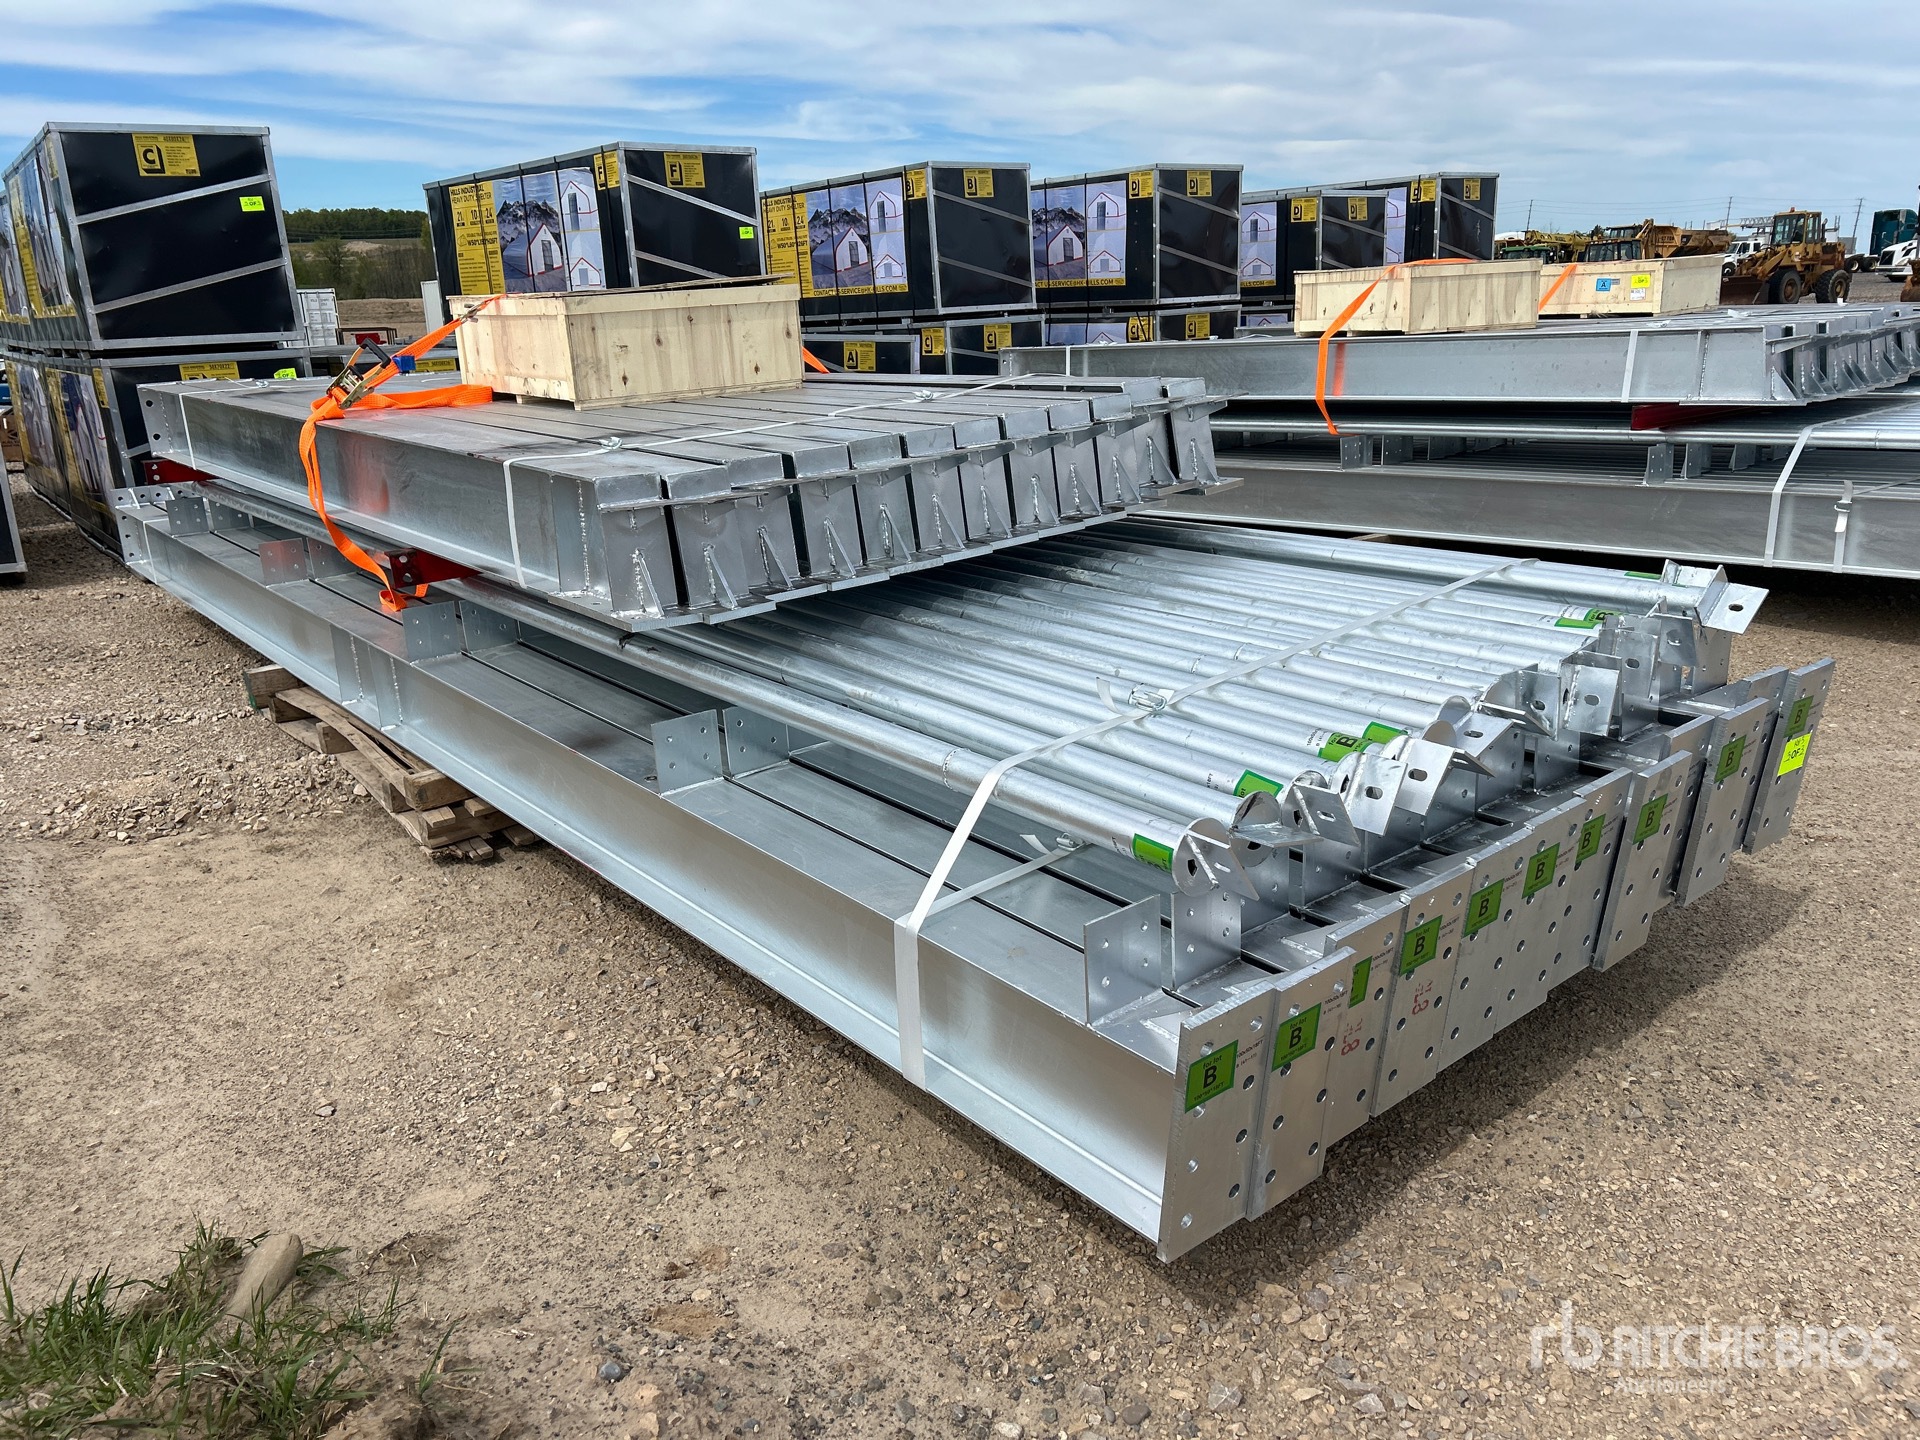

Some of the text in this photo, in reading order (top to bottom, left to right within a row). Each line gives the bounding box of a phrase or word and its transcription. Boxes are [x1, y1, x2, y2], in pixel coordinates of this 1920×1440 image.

[142, 148, 156, 165] C
[597, 166, 603, 180] F
[669, 164, 678, 178] F
[460, 184, 485, 194] INDUSTAL
[906, 180, 912, 192] B
[967, 178, 974, 190] B
[1131, 180, 1138, 191] D
[1189, 179, 1196, 190] D
[773, 195, 797, 206] INDUSTRIL
[775, 204, 787, 212] DUTY
[786, 202, 804, 210] SHLTER
[1293, 206, 1300, 216] D
[1350, 204, 1356, 214] D
[470, 209, 479, 221] 10
[485, 206, 493, 219] 24
[796, 214, 804, 225] 24
[813, 285, 834, 297] CONTACT
[1130, 325, 1136, 335] C
[1188, 322, 1194, 333] C
[924, 336, 930, 348] C
[986, 333, 993, 344] C
[847, 351, 855, 363] A
[1793, 708, 1803, 725] B
[1335, 736, 1358, 748] B
[1724, 750, 1735, 768] B
[1791, 748, 1801, 759] OF
[1644, 810, 1656, 829] B
[1581, 831, 1592, 850] B
[1535, 861, 1546, 881] B
[1478, 897, 1490, 918] B
[1413, 935, 1426, 957] B
[1289, 1026, 1303, 1050] B
[1203, 1055, 1223, 1069] for lot
[1202, 1065, 1218, 1090] B
